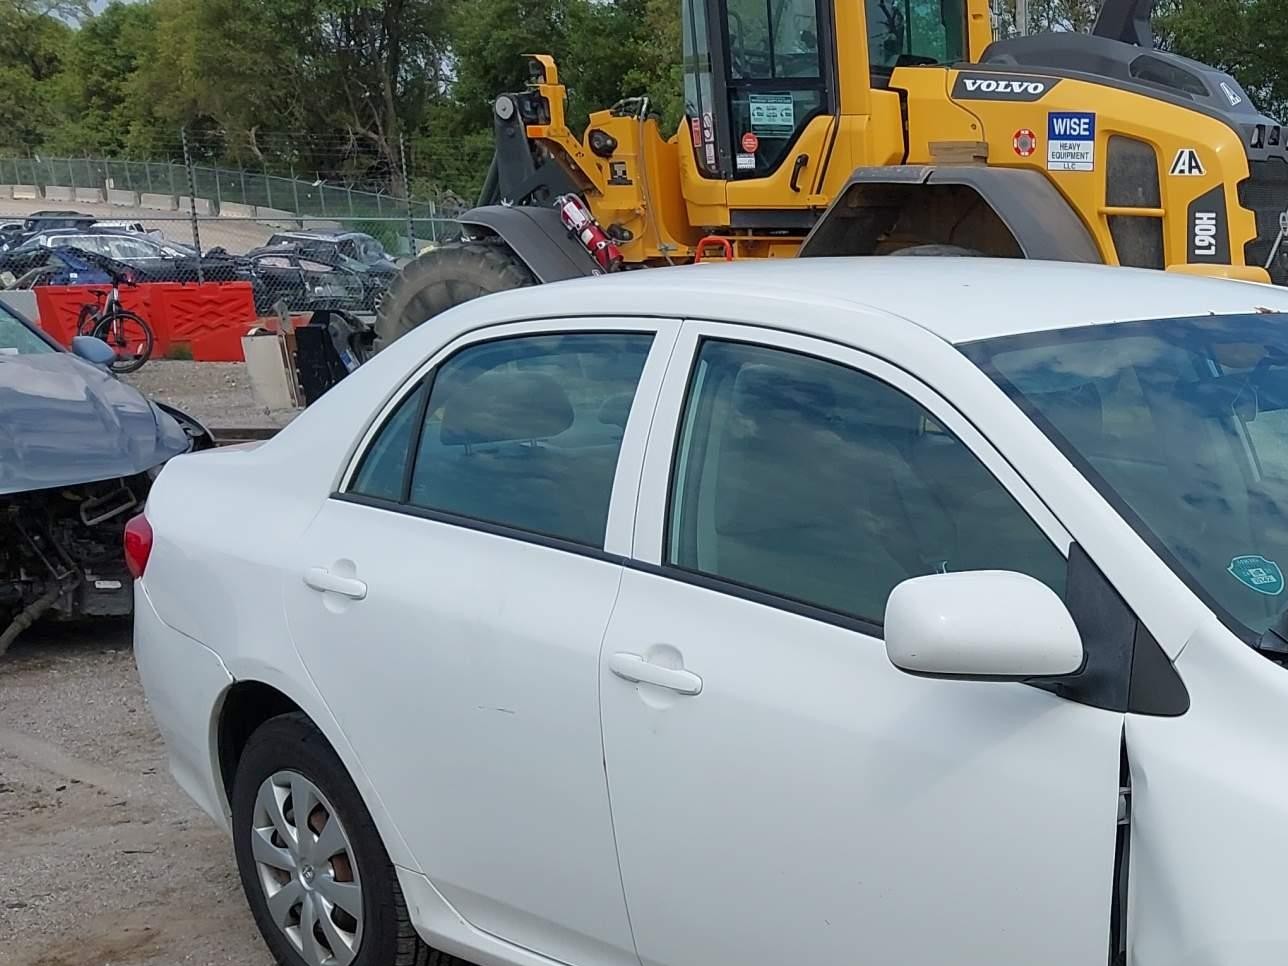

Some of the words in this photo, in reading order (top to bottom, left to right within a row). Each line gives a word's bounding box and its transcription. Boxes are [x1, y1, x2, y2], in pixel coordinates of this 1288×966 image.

[962, 79, 1045, 94] VOLVO
[1053, 117, 1090, 136] WISE
[1059, 142, 1081, 151] HEAVY
[1051, 151, 1090, 161] EQUIPMENT
[1063, 162, 1077, 170] LLC
[1194, 212, 1217, 256] L90H
